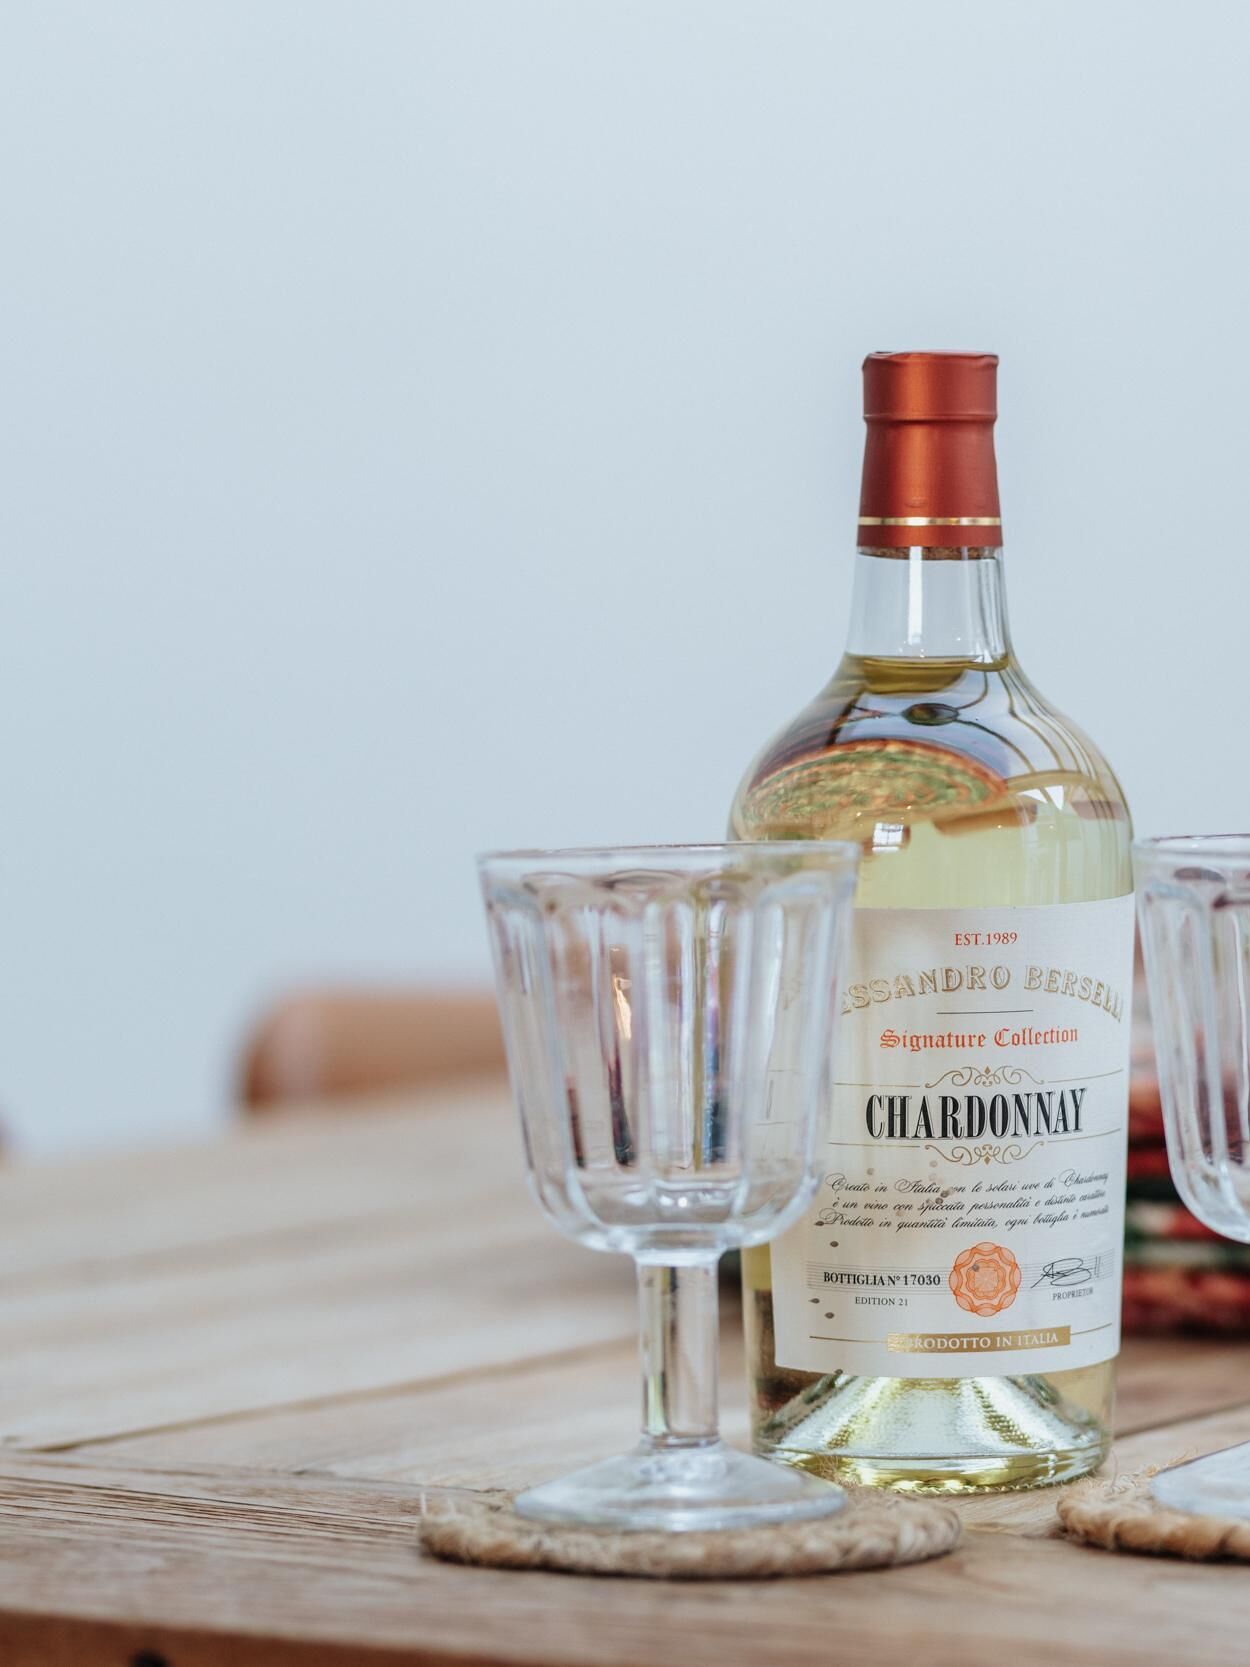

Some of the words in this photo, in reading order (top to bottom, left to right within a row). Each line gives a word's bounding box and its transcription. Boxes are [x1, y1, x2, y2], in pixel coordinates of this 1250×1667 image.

[953, 931, 1018, 946] EST.1989
[880, 1028, 986, 1052] Signature
[994, 1025, 1079, 1047] Collection
[866, 1087, 1087, 1140] CHARDONNAY
[825, 1173, 870, 1195] Creato
[874, 1182, 888, 1193] in
[894, 1179, 940, 1194] Italia
[971, 1180, 983, 1193] le
[985, 1180, 1020, 1193] solari
[1021, 1182, 1040, 1191] uve
[1043, 1177, 1056, 1189] di
[842, 1200, 858, 1209] un
[863, 1199, 889, 1210] vino
[893, 1202, 913, 1211] con
[819, 1207, 875, 1227] Prodotto
[878, 1217, 892, 1228] in
[895, 1217, 947, 1233] quantità
[1004, 1214, 1029, 1231] ogni
[1032, 1210, 1070, 1228] bottiglia
[823, 1271, 886, 1286] BOTTIGLIA
[903, 1274, 941, 1286] 17030
[855, 1296, 895, 1306] EDITION
[898, 1297, 909, 1306] 21
[996, 1336, 1012, 1347] IN
[1017, 1331, 1059, 1347] ITALIA
